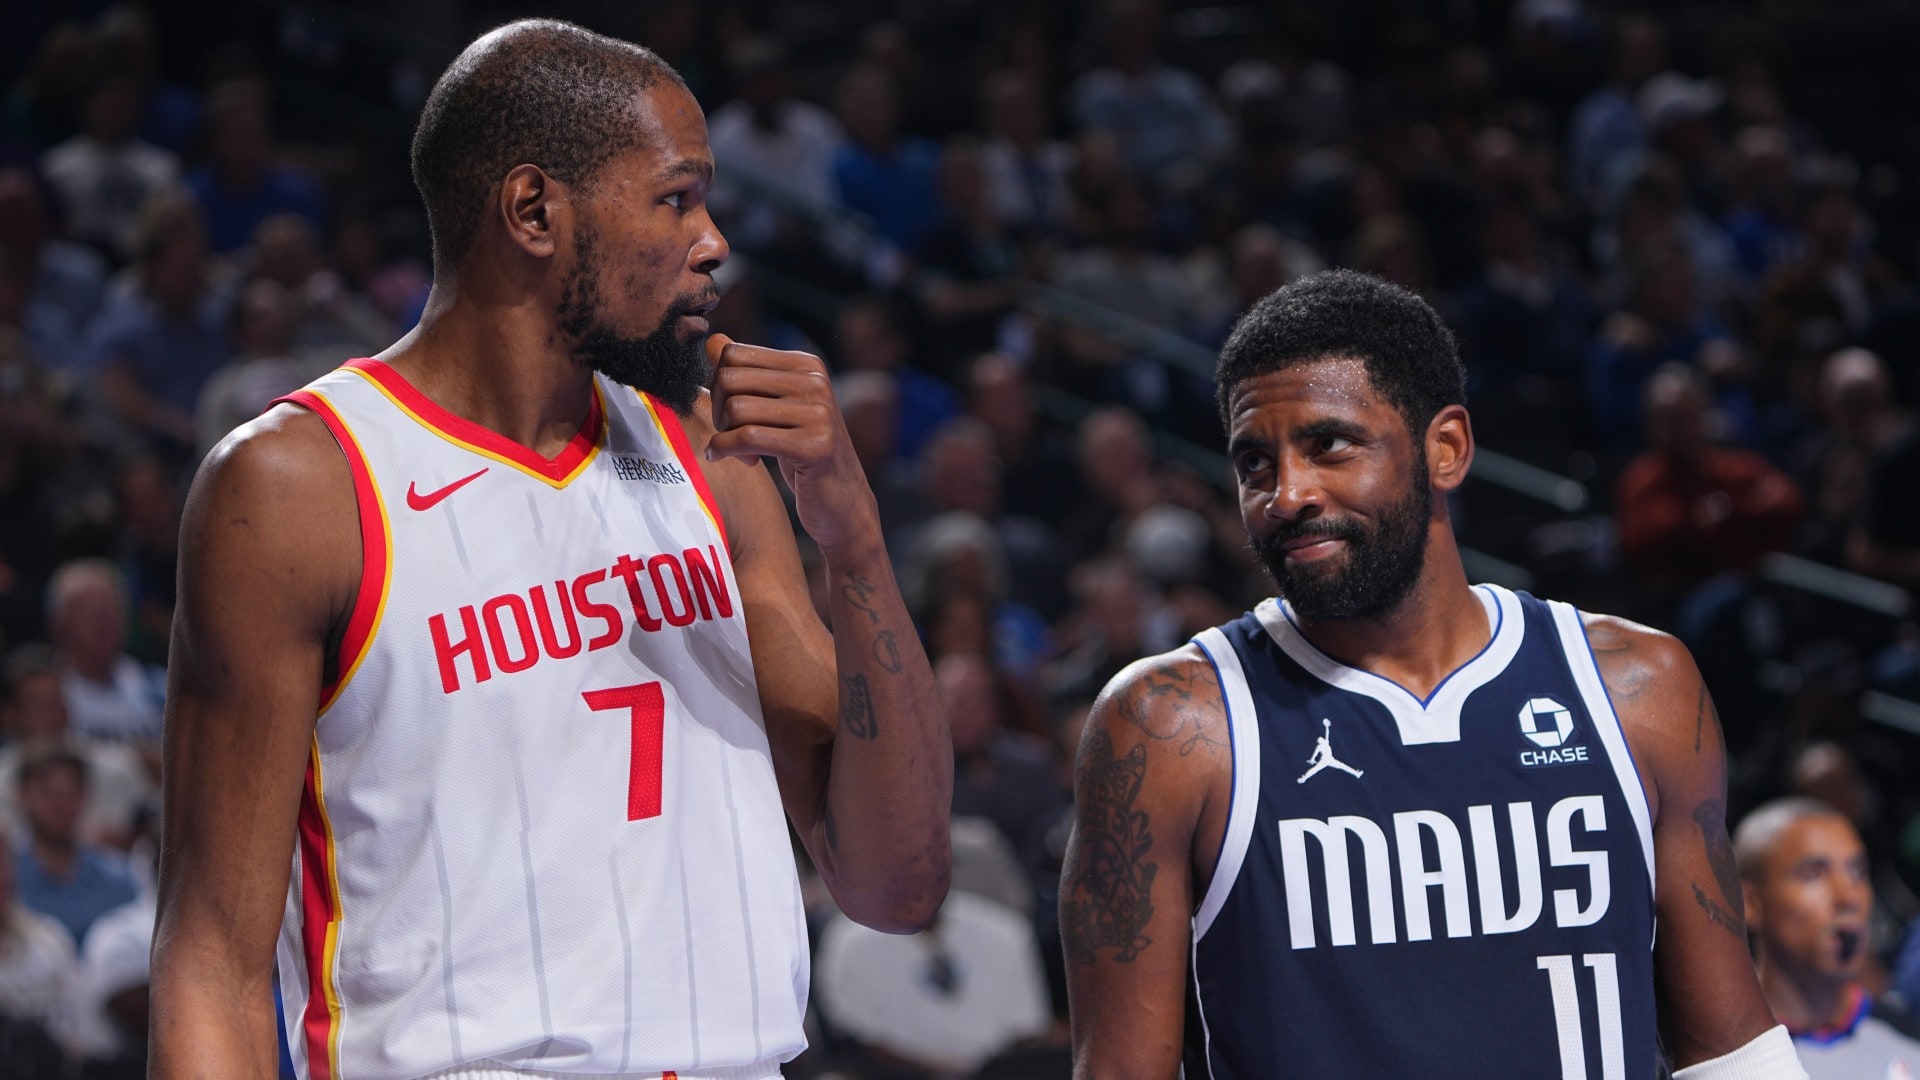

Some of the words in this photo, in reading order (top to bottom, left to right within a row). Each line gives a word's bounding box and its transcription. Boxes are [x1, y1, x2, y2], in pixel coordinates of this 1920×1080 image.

[612, 456, 681, 475] MEMORIAL
[616, 466, 685, 485] HERMANN
[428, 544, 733, 694] HOUSTON
[581, 681, 665, 821] 7
[1520, 746, 1589, 766] CHASE
[1278, 795, 1611, 949] MAVS
[1536, 953, 1625, 1080] 11
